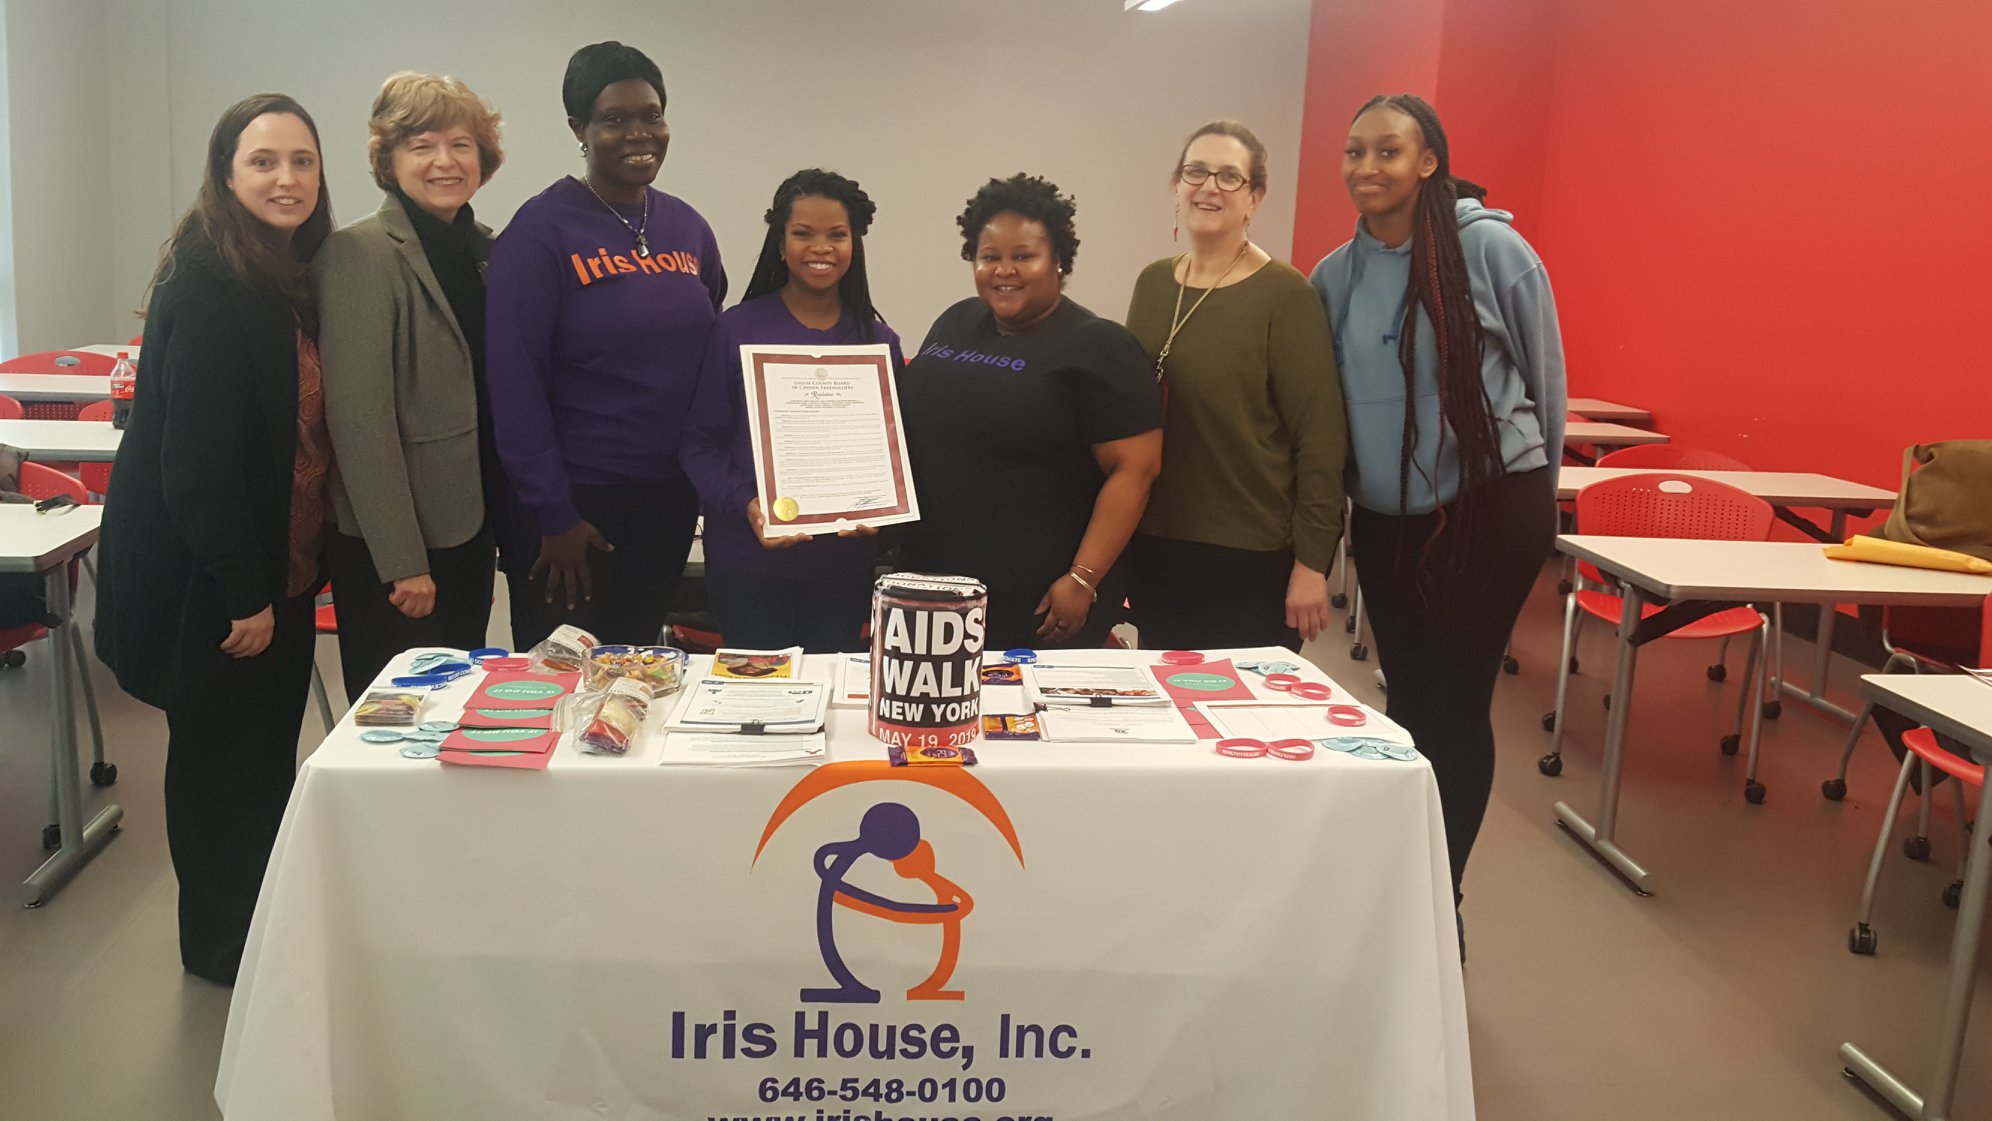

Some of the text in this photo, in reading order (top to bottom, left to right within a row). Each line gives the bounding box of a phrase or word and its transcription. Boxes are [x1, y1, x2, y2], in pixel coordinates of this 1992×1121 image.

[571, 247, 700, 286] Iris Hous
[921, 342, 1026, 371] Iris House
[884, 607, 985, 656] AIDS
[882, 655, 982, 698] WALK
[879, 697, 979, 723] NEW YORK
[879, 727, 913, 748] MAY
[949, 727, 977, 747] 2019
[670, 1010, 1092, 1071] Iris House, Inc.
[757, 1076, 1006, 1104] 646-548-0100
